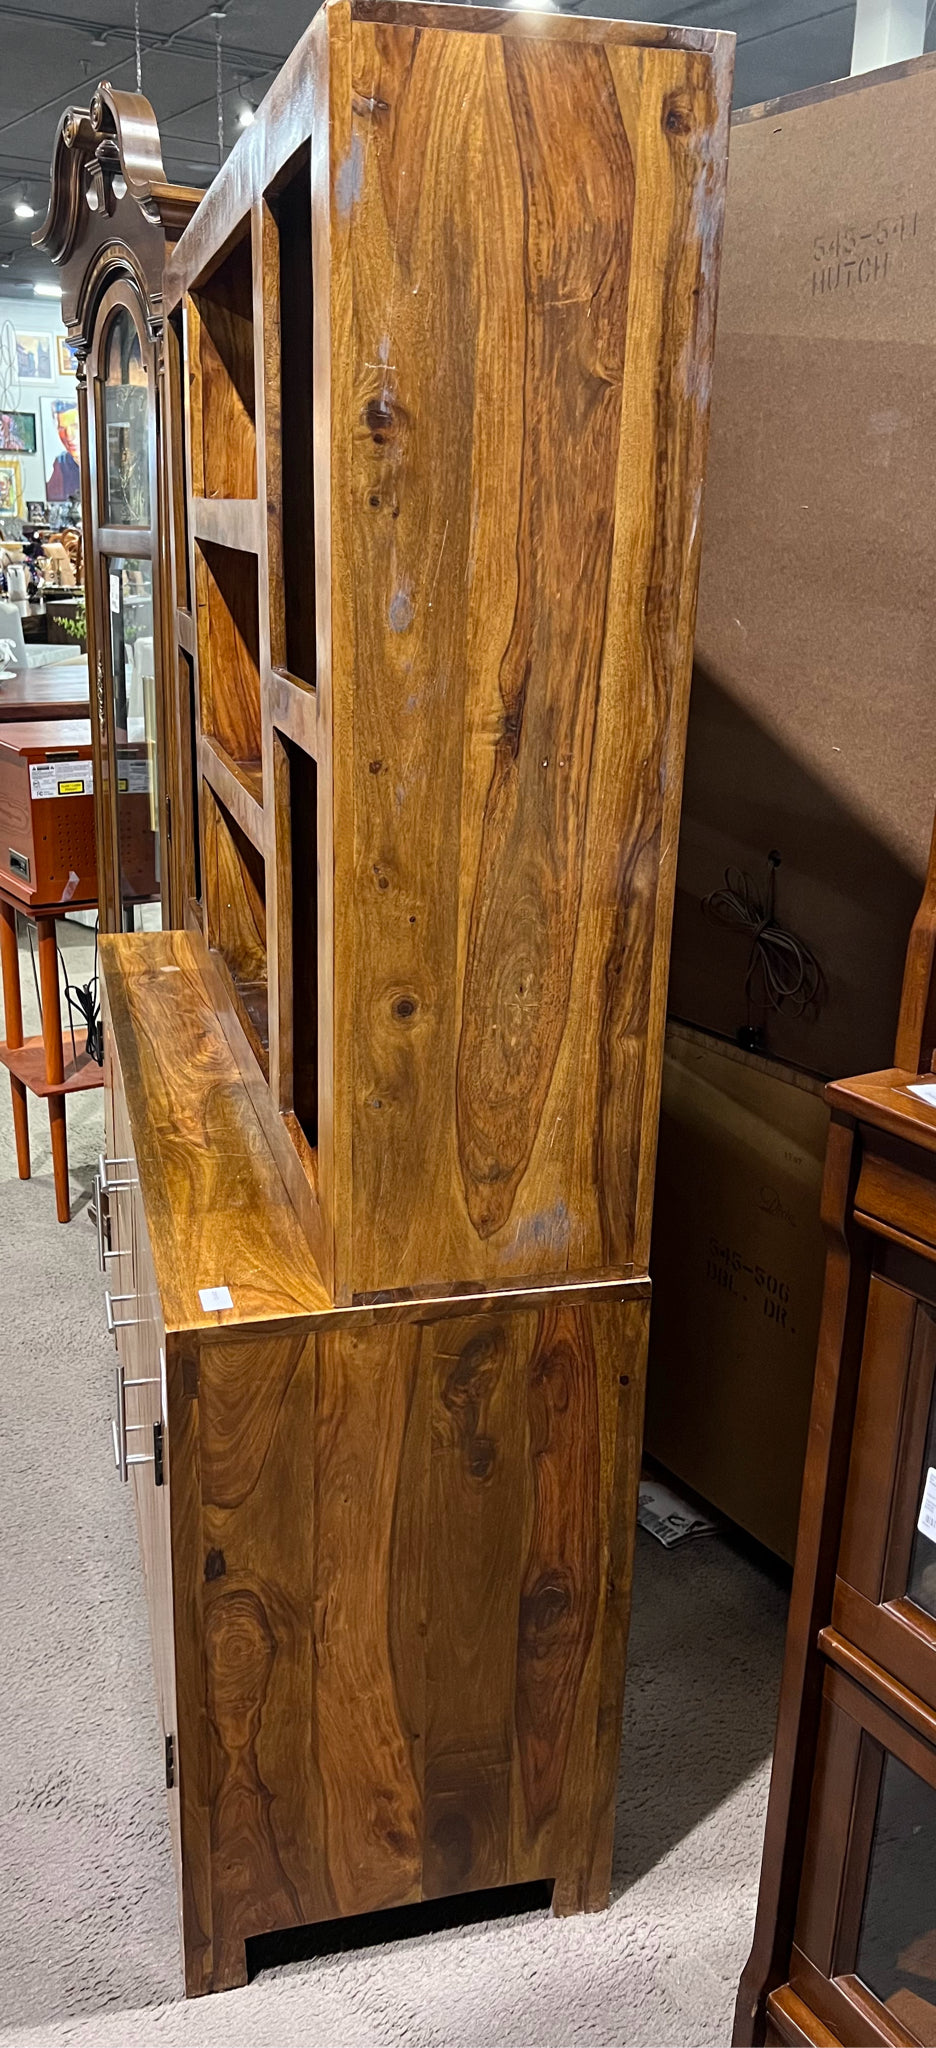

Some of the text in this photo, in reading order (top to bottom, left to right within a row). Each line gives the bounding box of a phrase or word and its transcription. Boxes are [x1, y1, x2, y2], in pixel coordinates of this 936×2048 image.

[814, 211, 918, 261] 545-541
[812, 252, 889, 296] HUTCH
[708, 1232, 791, 1303] 545-506
[763, 1297, 796, 1334] DR.
